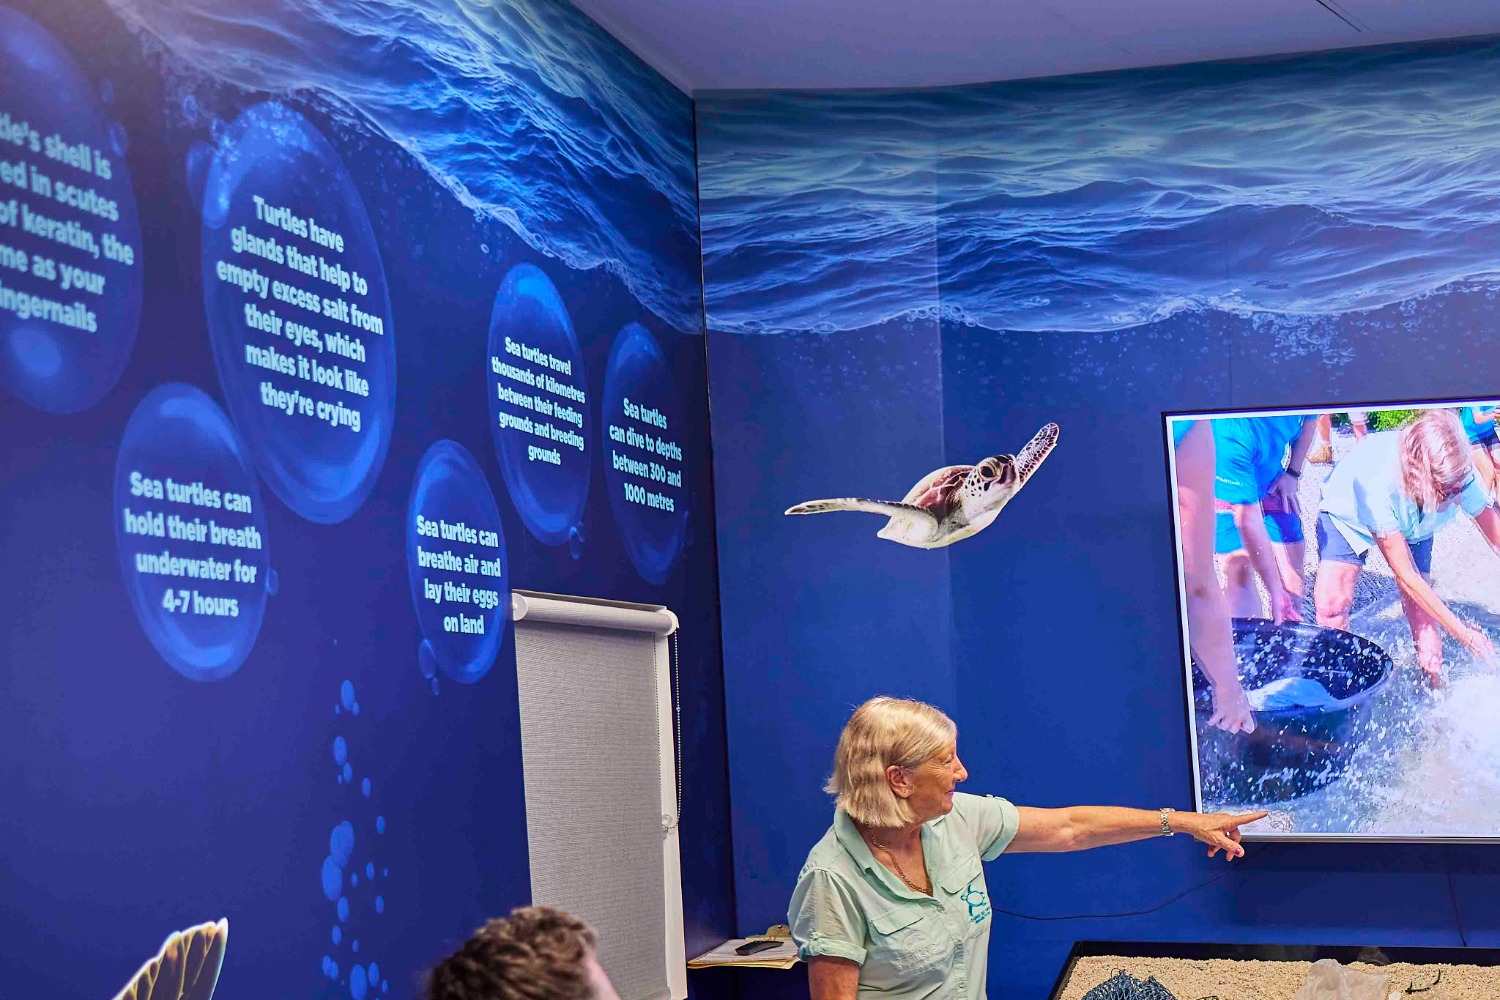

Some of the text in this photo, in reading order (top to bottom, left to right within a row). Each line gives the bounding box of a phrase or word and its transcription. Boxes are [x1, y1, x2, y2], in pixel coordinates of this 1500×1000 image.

[44, 133, 92, 173] shell
[94, 150, 113, 180] is
[30, 165, 52, 197] in
[54, 181, 119, 222] scutes
[0, 199, 134, 265] of keratin, the
[253, 194, 344, 253] Turtles have
[32, 254, 57, 281] as
[60, 262, 106, 295] your
[231, 226, 368, 296] glands that help to
[216, 260, 384, 335] empty excess salt from
[244, 303, 366, 362] their eyes, which
[245, 345, 369, 397] makes it look like
[505, 336, 571, 375] Sea turtles travel
[491, 356, 585, 403] thousands of kilometres
[260, 382, 361, 432] they're crying
[497, 382, 583, 428] between their feeding
[624, 398, 667, 429] Sea turtles
[499, 412, 584, 451] grounds and breeding
[610, 425, 682, 461] can dive to depths
[528, 445, 561, 465] grounds
[613, 450, 681, 487] between 300 and
[130, 471, 252, 513] Sea turtles can
[624, 483, 674, 512] 1000 metres
[124, 508, 262, 549] hold their breath
[416, 515, 498, 547] Sea turtles can
[136, 551, 257, 583] underwater for
[417, 546, 501, 577] breathe air and
[163, 588, 239, 617] 4-7 hours
[424, 578, 498, 609] lay their eggs
[443, 613, 484, 634] on land
